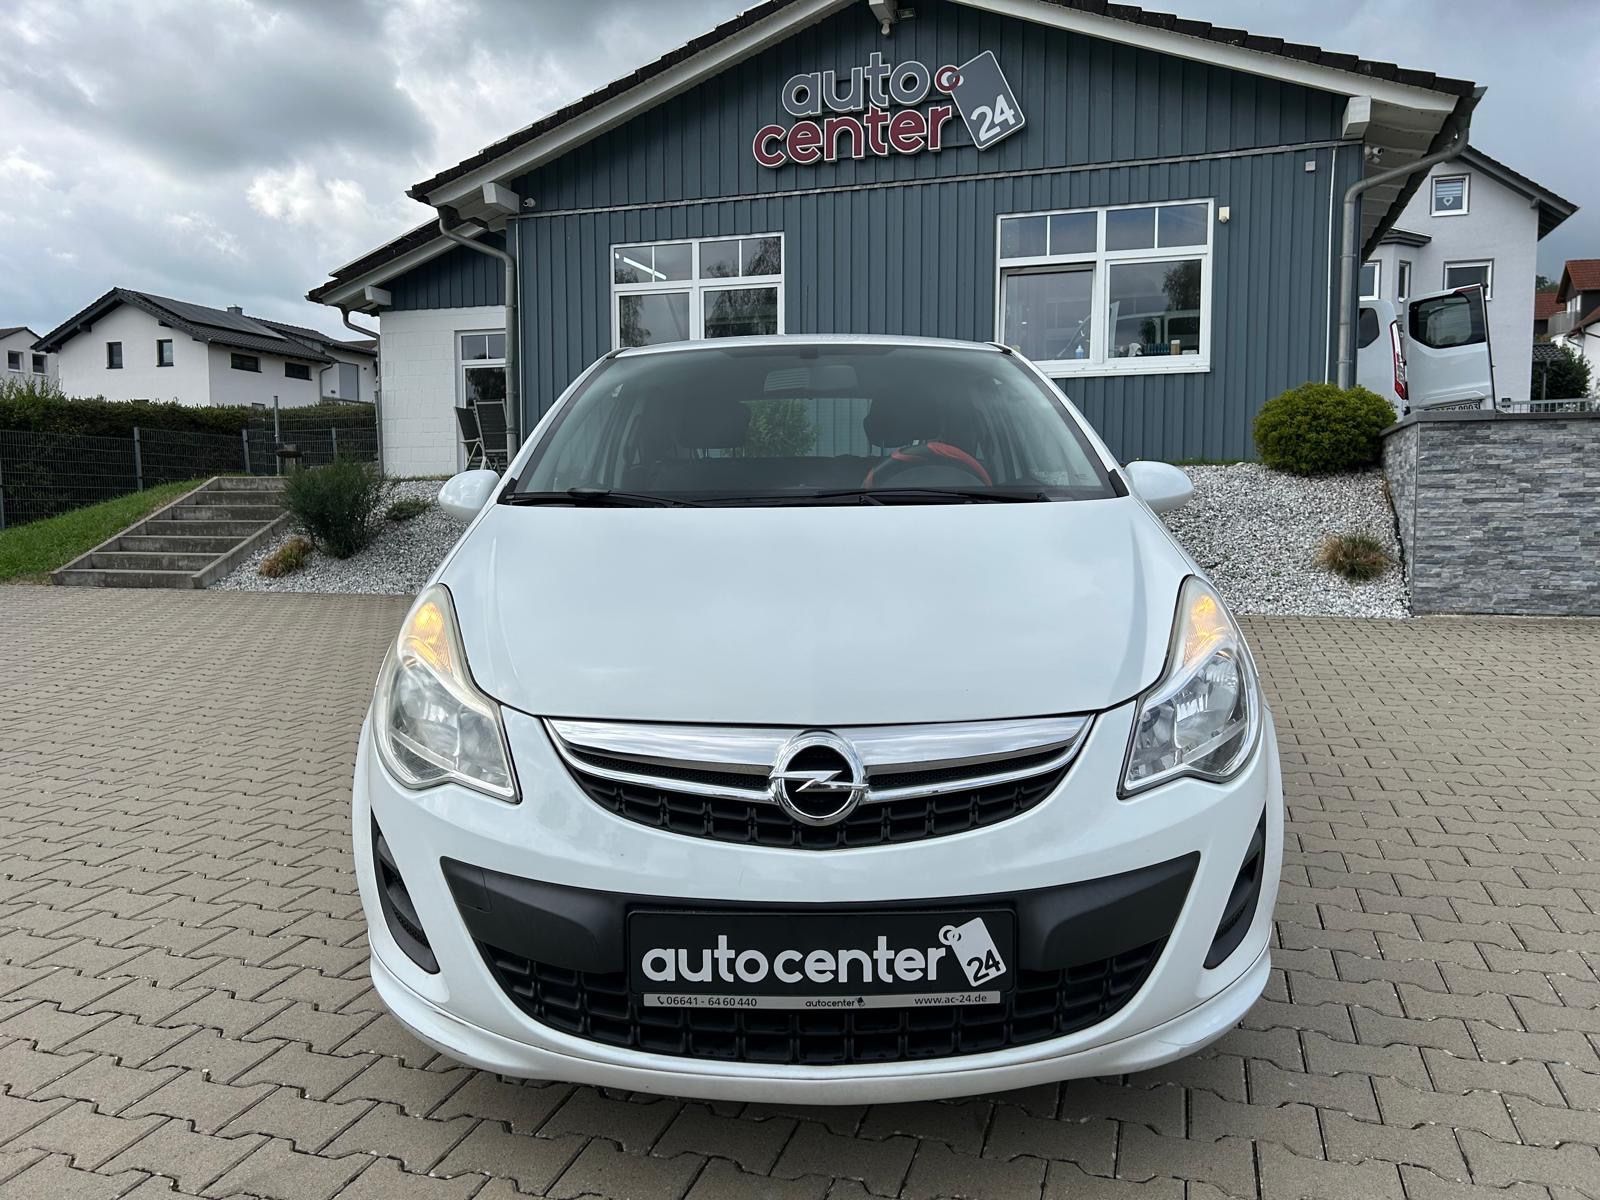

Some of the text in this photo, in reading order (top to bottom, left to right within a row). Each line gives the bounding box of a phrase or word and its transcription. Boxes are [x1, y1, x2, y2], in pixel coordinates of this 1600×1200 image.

[782, 51, 931, 117] auto
[752, 102, 952, 168] center
[969, 93, 1016, 142] 24
[966, 948, 1002, 983] 24
[666, 996, 698, 1006] 06641
[805, 999, 856, 1008] autocenter
[914, 993, 988, 1005] www.ac-24.de
